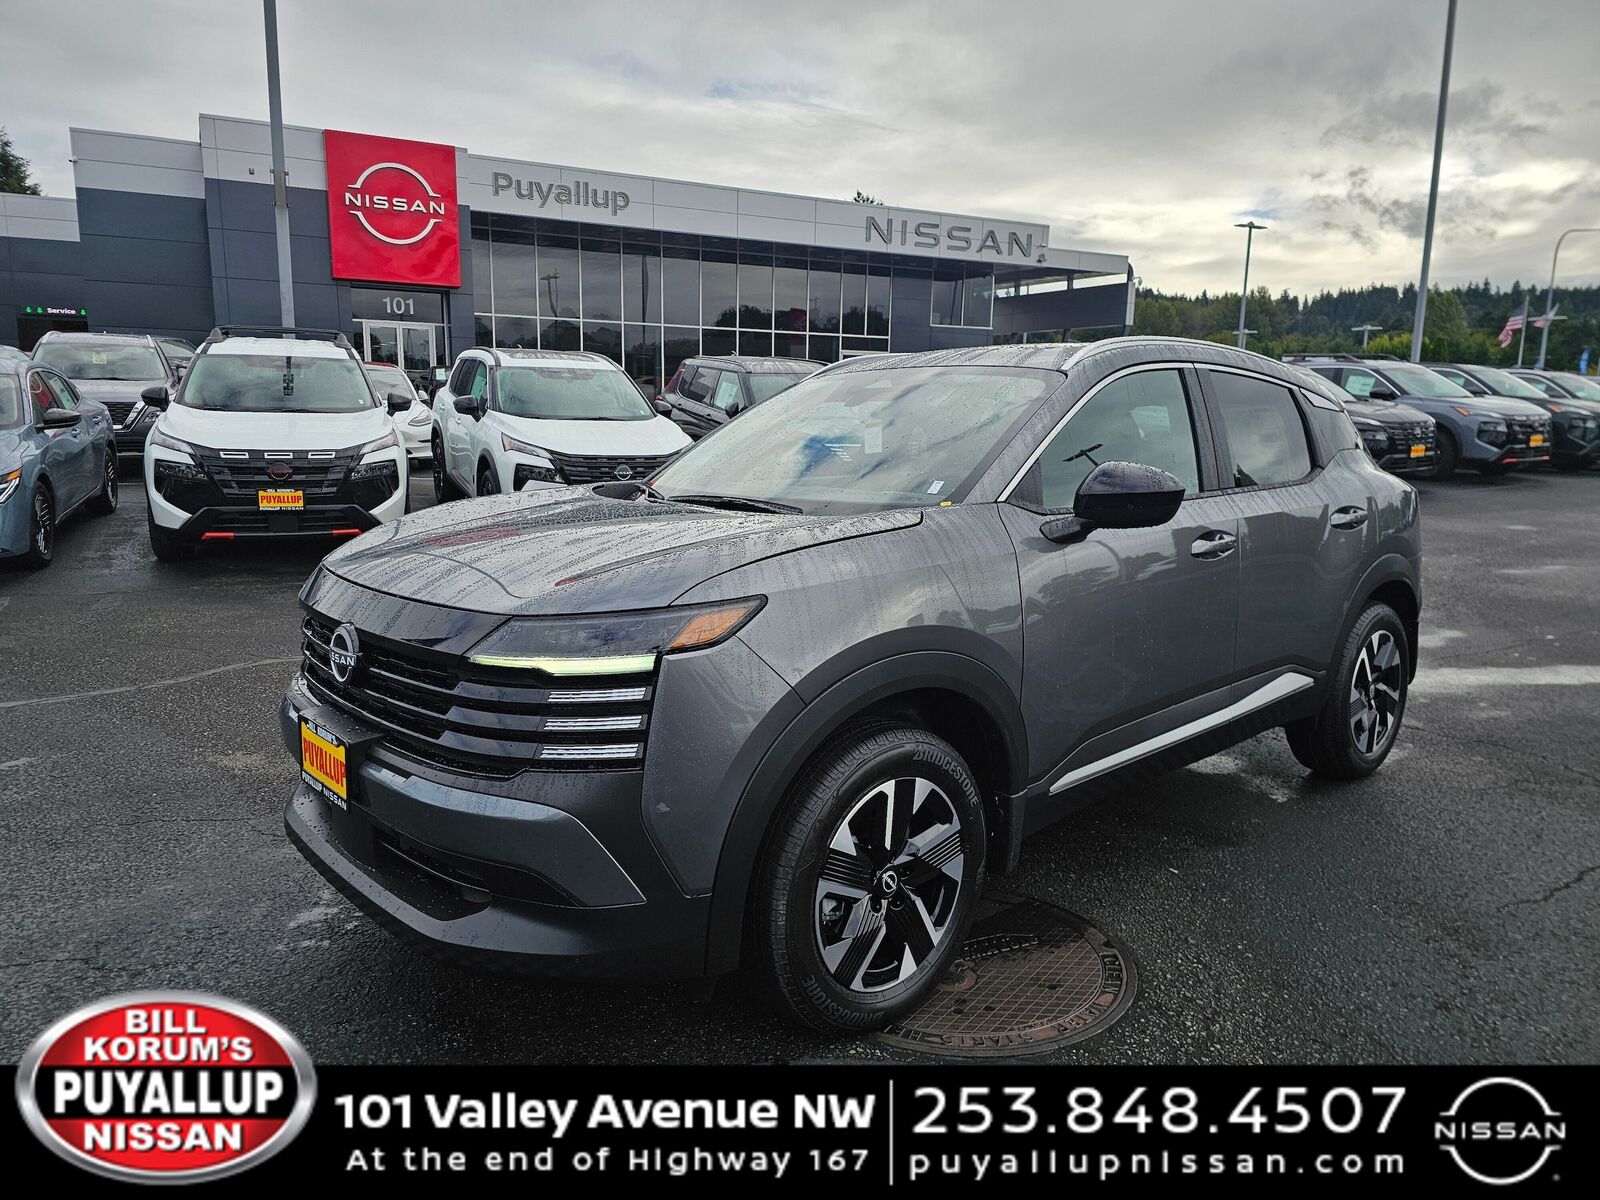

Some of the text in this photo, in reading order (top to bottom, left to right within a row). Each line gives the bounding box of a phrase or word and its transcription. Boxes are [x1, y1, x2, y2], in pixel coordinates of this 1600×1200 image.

[344, 191, 446, 216] NISSAN
[491, 171, 631, 216] Puyallup
[864, 215, 1034, 258] NISSAN
[46, 306, 77, 316] Service
[382, 297, 416, 316] 101
[260, 495, 302, 504] PUYALLUP
[302, 735, 347, 789] PUYALLUP
[912, 744, 980, 809] BRIDGESTONE
[323, 786, 347, 812] NISSAN
